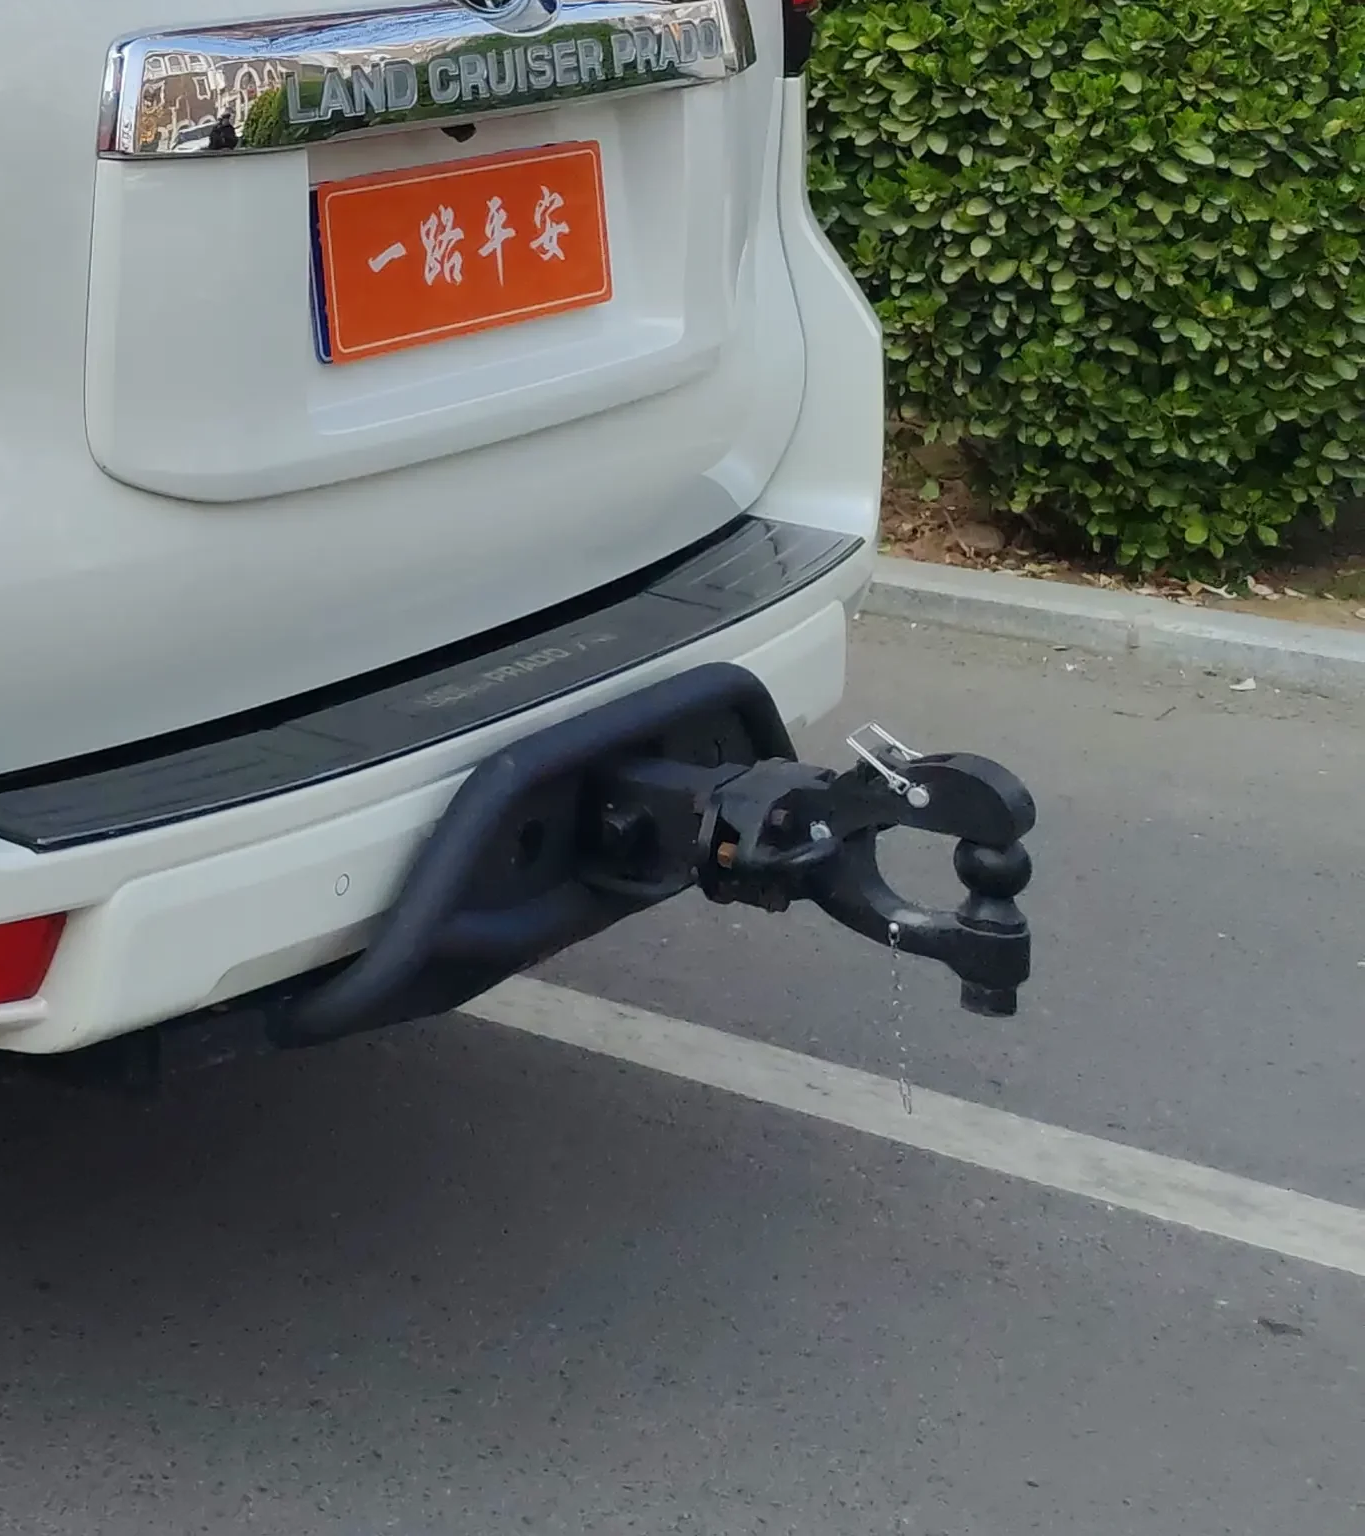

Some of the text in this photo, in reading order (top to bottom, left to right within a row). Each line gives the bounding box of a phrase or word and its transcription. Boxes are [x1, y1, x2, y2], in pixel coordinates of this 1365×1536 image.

[284, 17, 722, 124] LAND CRUISER PRADO
[368, 185, 570, 287] 一路平安
[483, 648, 571, 683] PRADO
